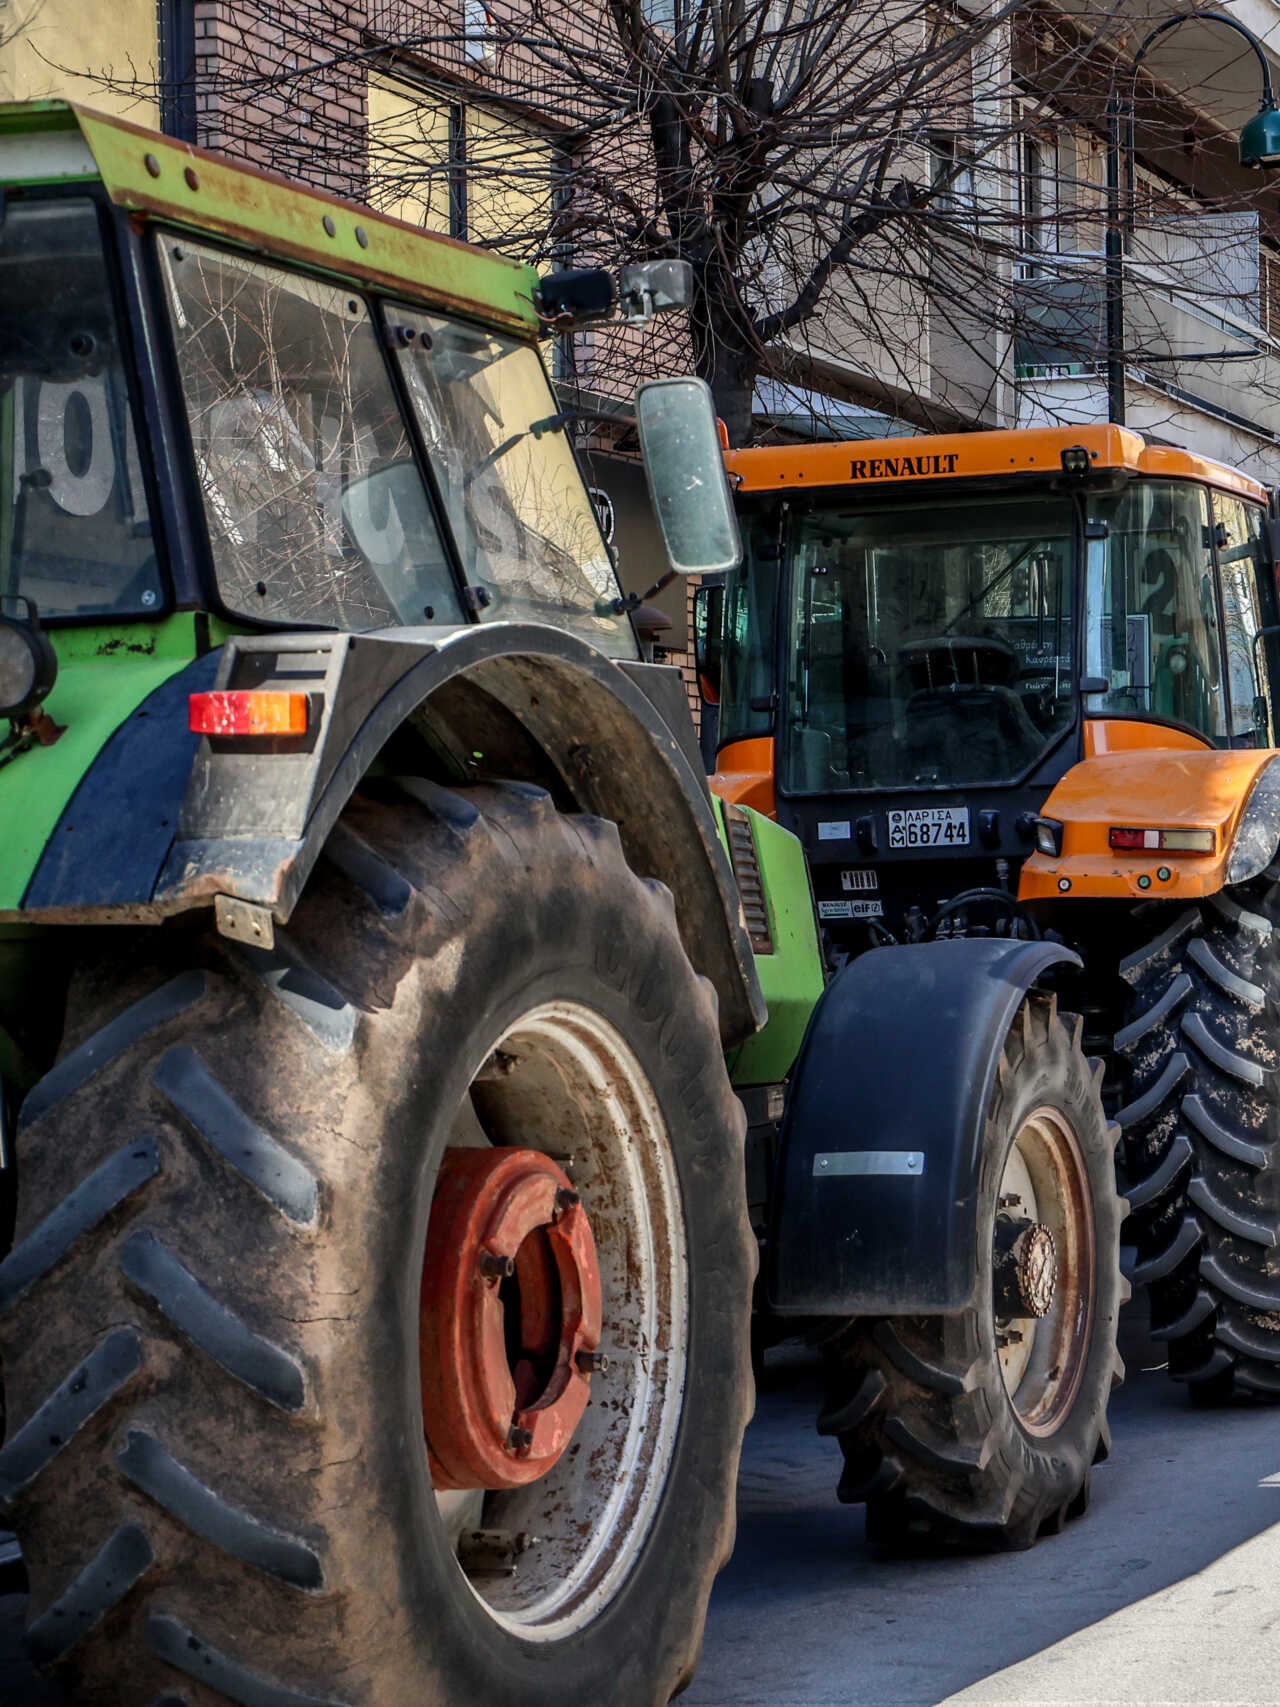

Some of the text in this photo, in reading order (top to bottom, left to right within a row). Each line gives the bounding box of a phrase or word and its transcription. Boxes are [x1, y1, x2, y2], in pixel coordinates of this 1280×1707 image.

[850, 454, 959, 479] RENAULT
[907, 810, 953, 822] ΛΑΡΙΣΑ
[908, 821, 967, 845] 68744
